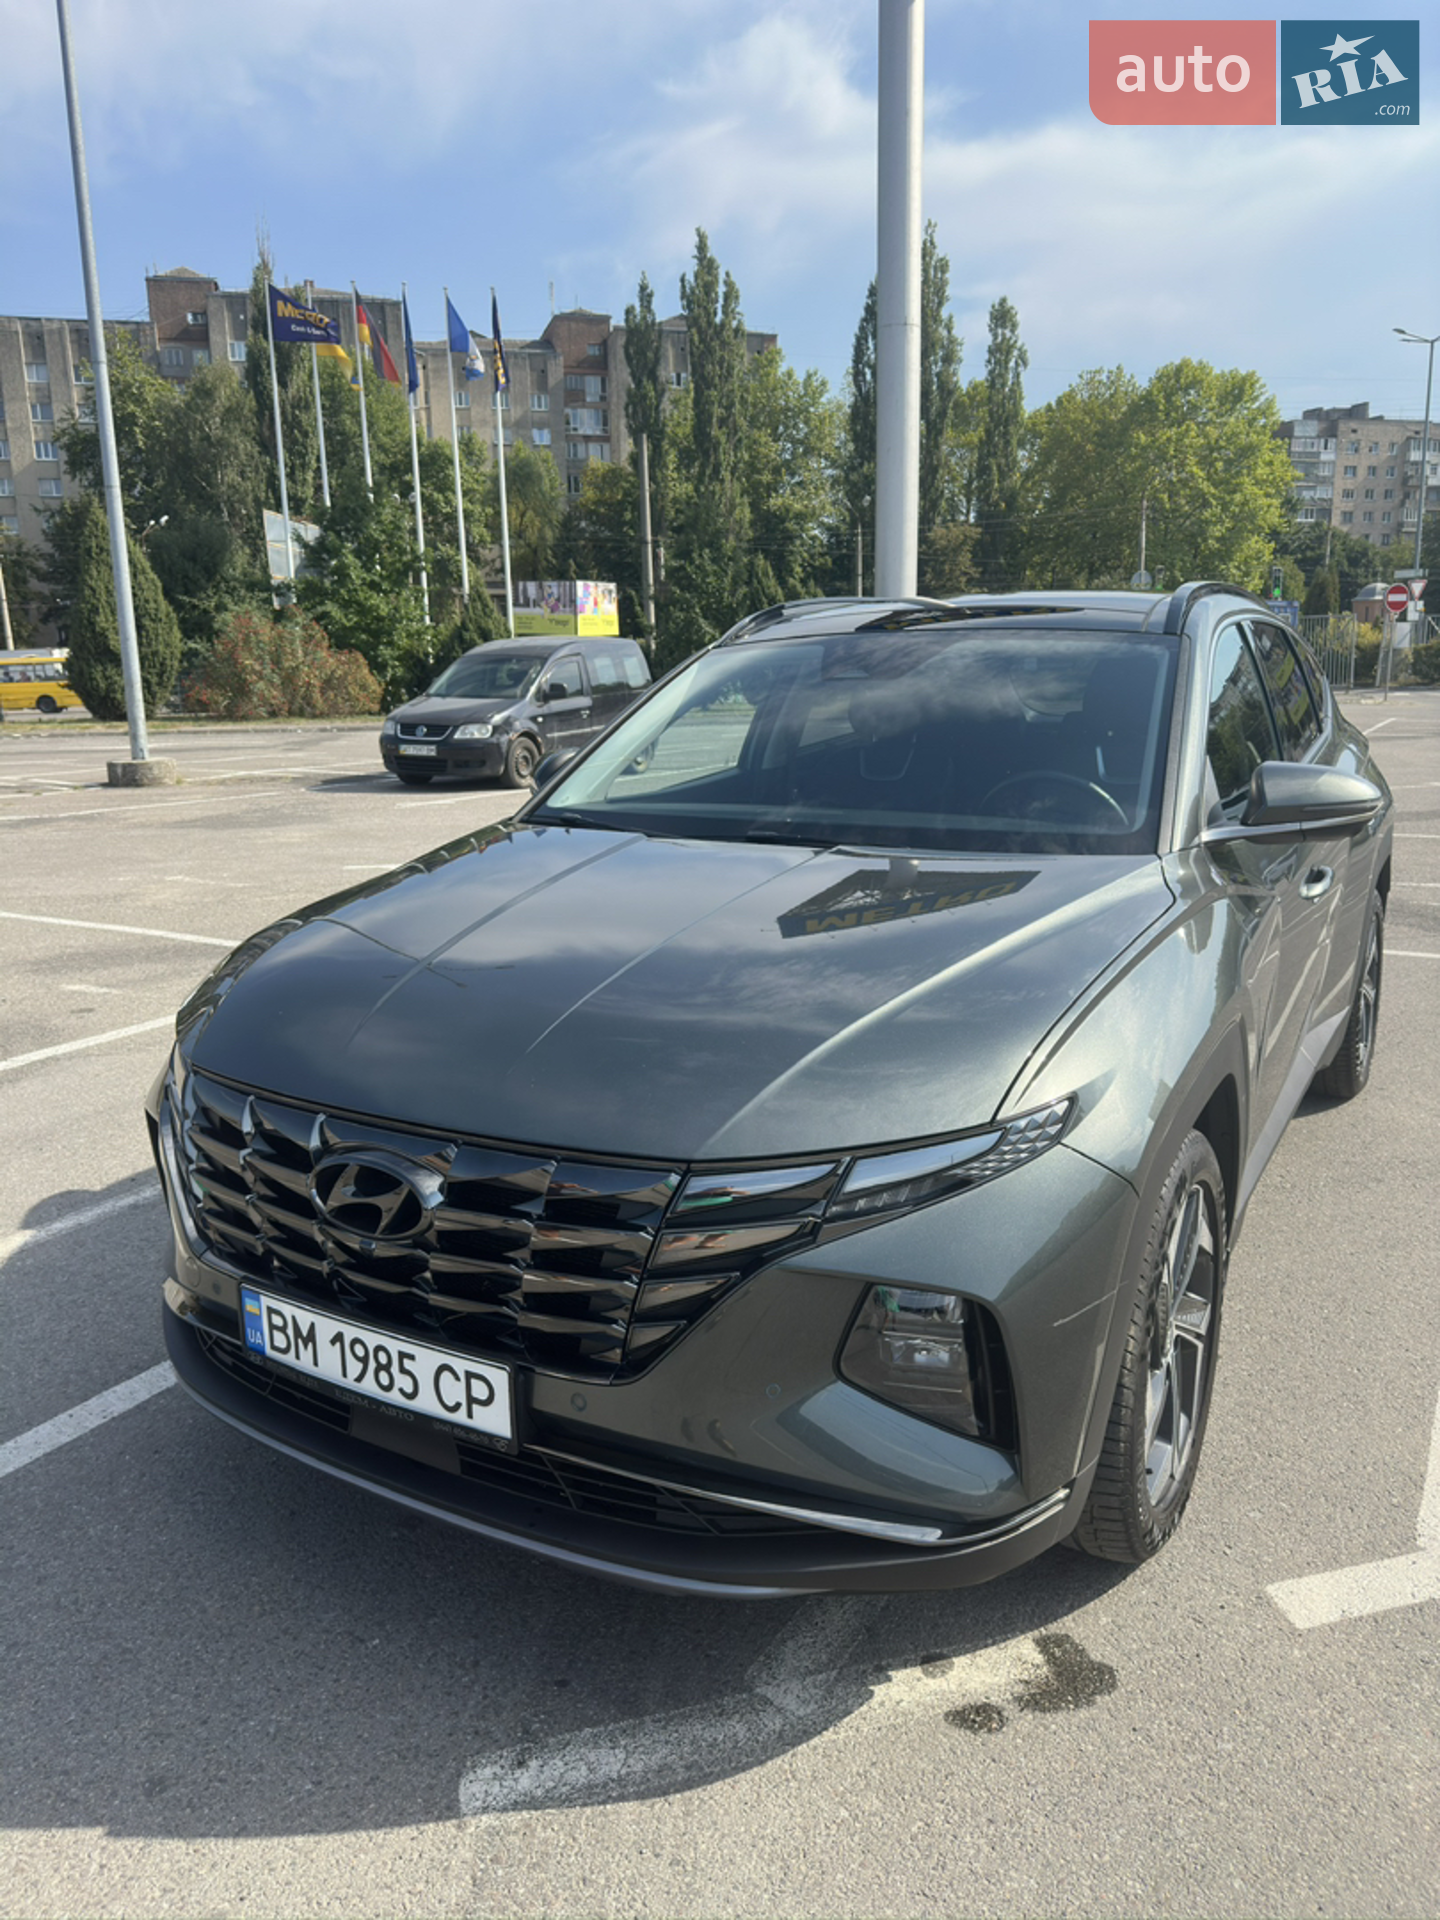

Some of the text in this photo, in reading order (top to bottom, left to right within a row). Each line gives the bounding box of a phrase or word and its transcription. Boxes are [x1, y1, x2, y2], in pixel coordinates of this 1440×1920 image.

[247, 1327, 263, 1347] UA
[266, 1305, 319, 1368] BM
[329, 1331, 419, 1401] 1985
[433, 1363, 495, 1420] CP
